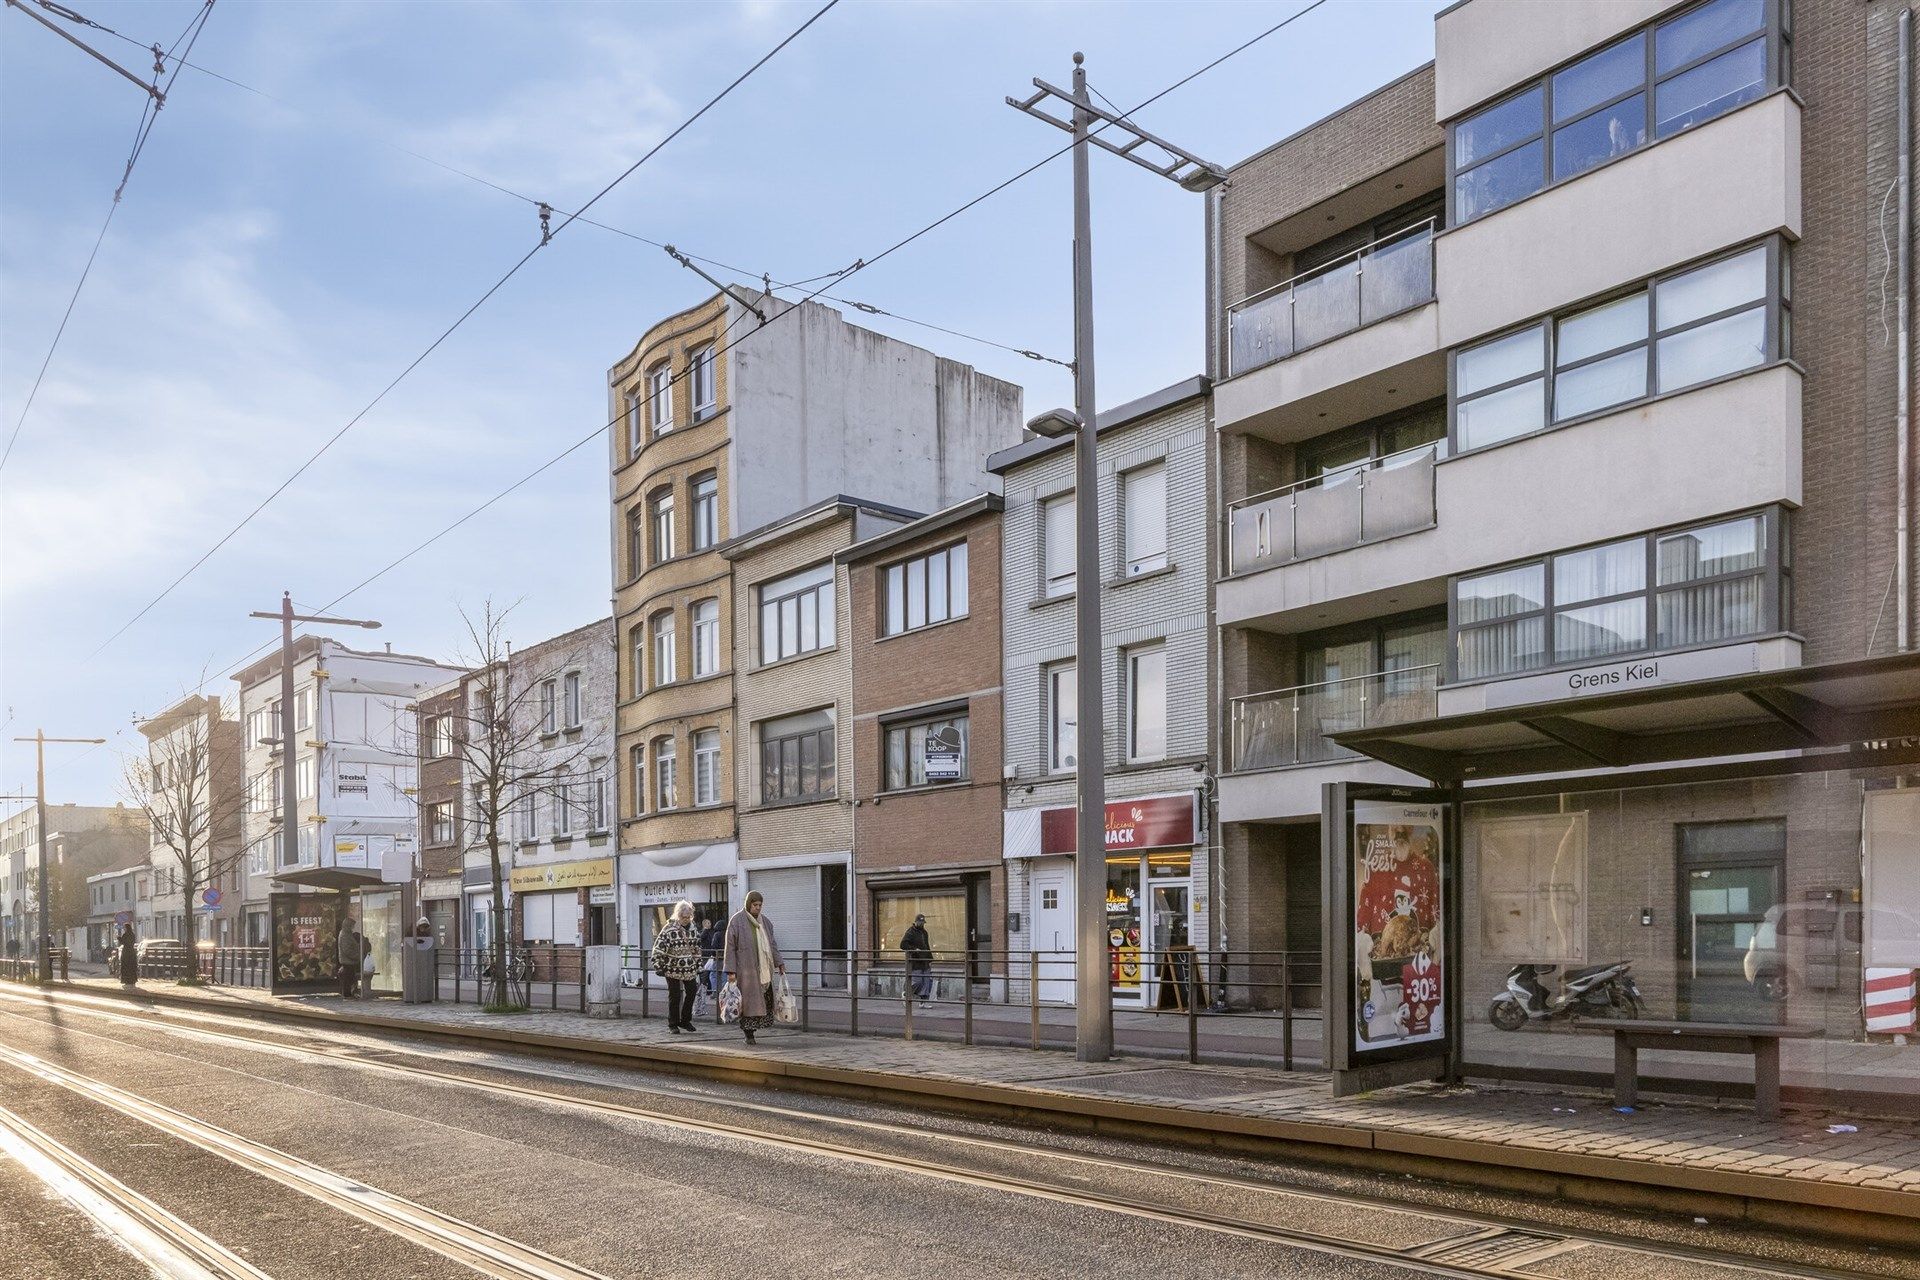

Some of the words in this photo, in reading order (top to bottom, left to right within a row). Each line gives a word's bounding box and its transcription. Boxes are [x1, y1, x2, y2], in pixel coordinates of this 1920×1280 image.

[1569, 671, 1620, 689] Grens
[1626, 662, 1658, 681] Kiel
[1360, 839, 1397, 883] feest
[645, 884, 665, 896] Outlet
[667, 884, 672, 894] R
[673, 883, 678, 894] &
[290, 917, 299, 925] IS
[300, 916, 322, 925] FEEST
